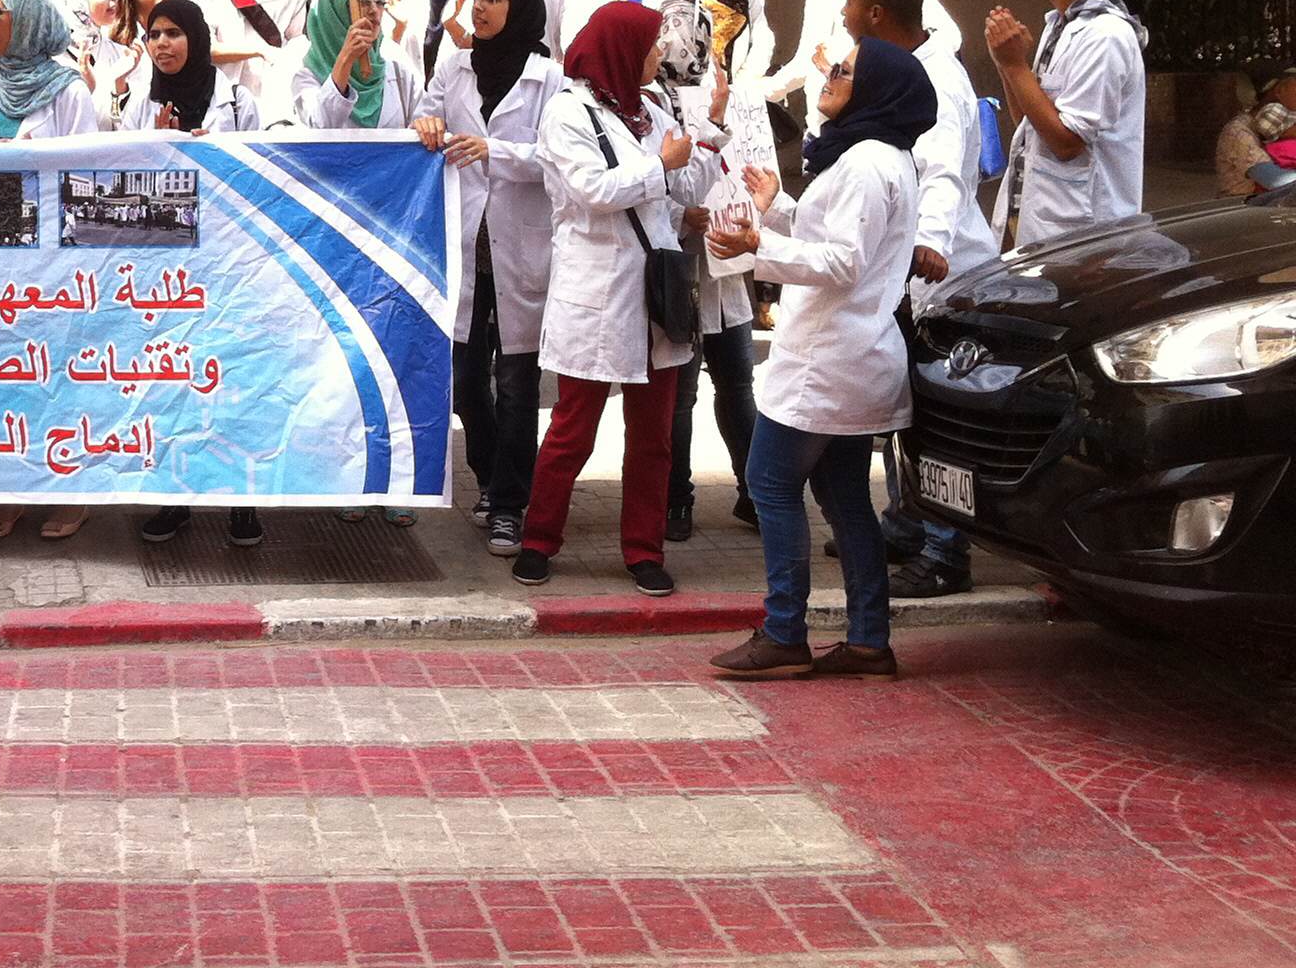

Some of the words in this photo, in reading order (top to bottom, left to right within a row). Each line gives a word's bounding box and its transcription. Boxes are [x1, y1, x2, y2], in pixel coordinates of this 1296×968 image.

[115, 265, 206, 322] طلبة
[69, 340, 220, 394] وتقنيات
[46, 416, 154, 474] إدماج
